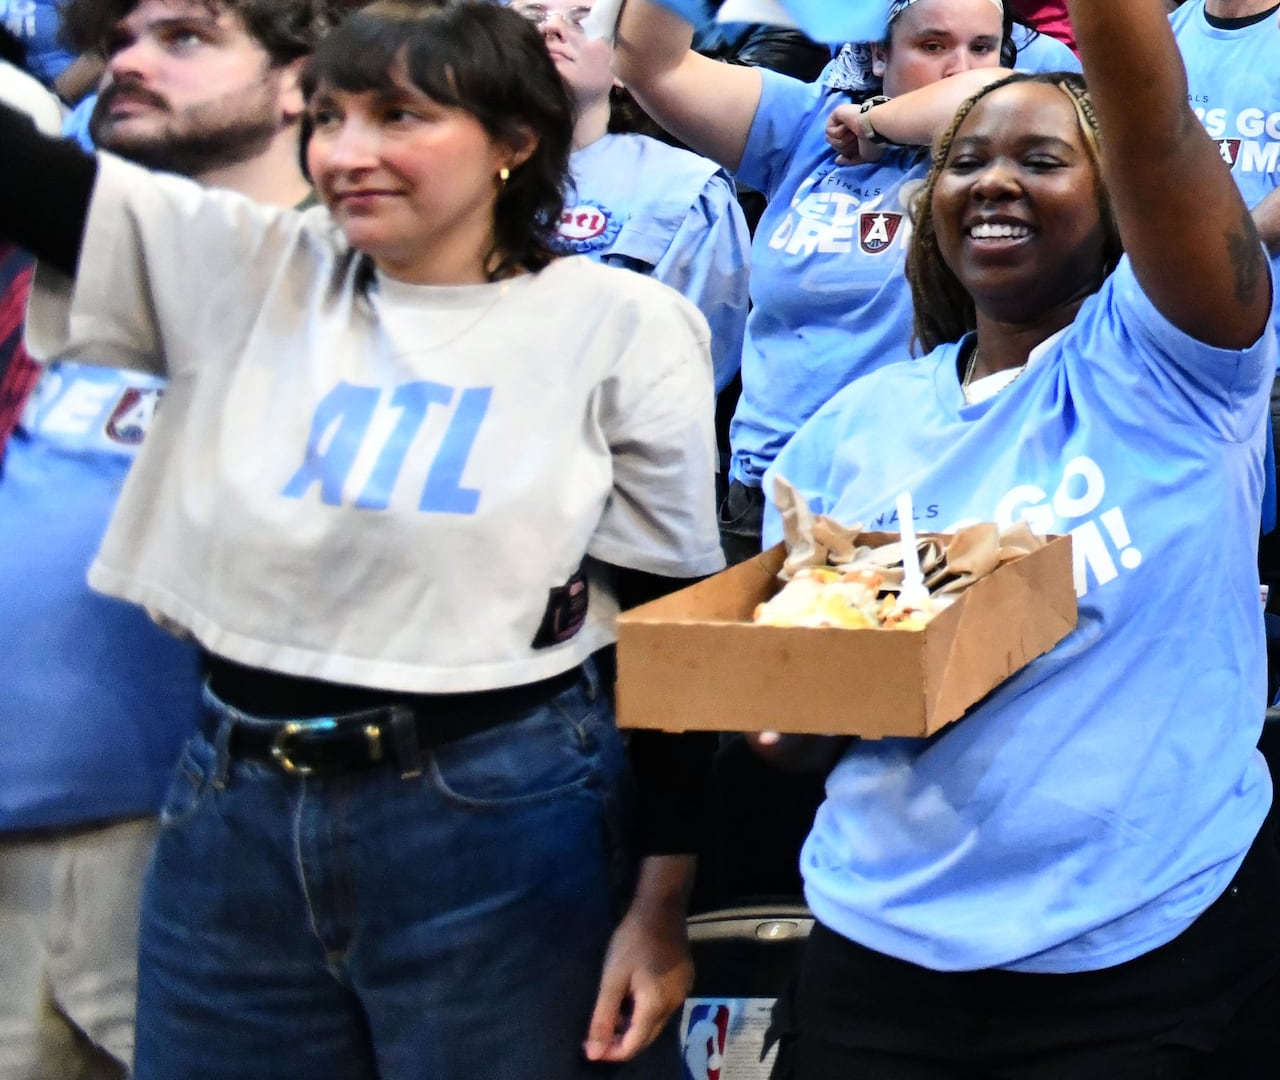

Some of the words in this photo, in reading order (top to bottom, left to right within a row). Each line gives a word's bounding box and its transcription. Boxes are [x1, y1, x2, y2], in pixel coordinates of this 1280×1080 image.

[1187, 94, 1209, 103] ALS
[827, 175, 883, 197] FINALS
[281, 381, 494, 515] ATL
[994, 455, 1106, 536] GO
